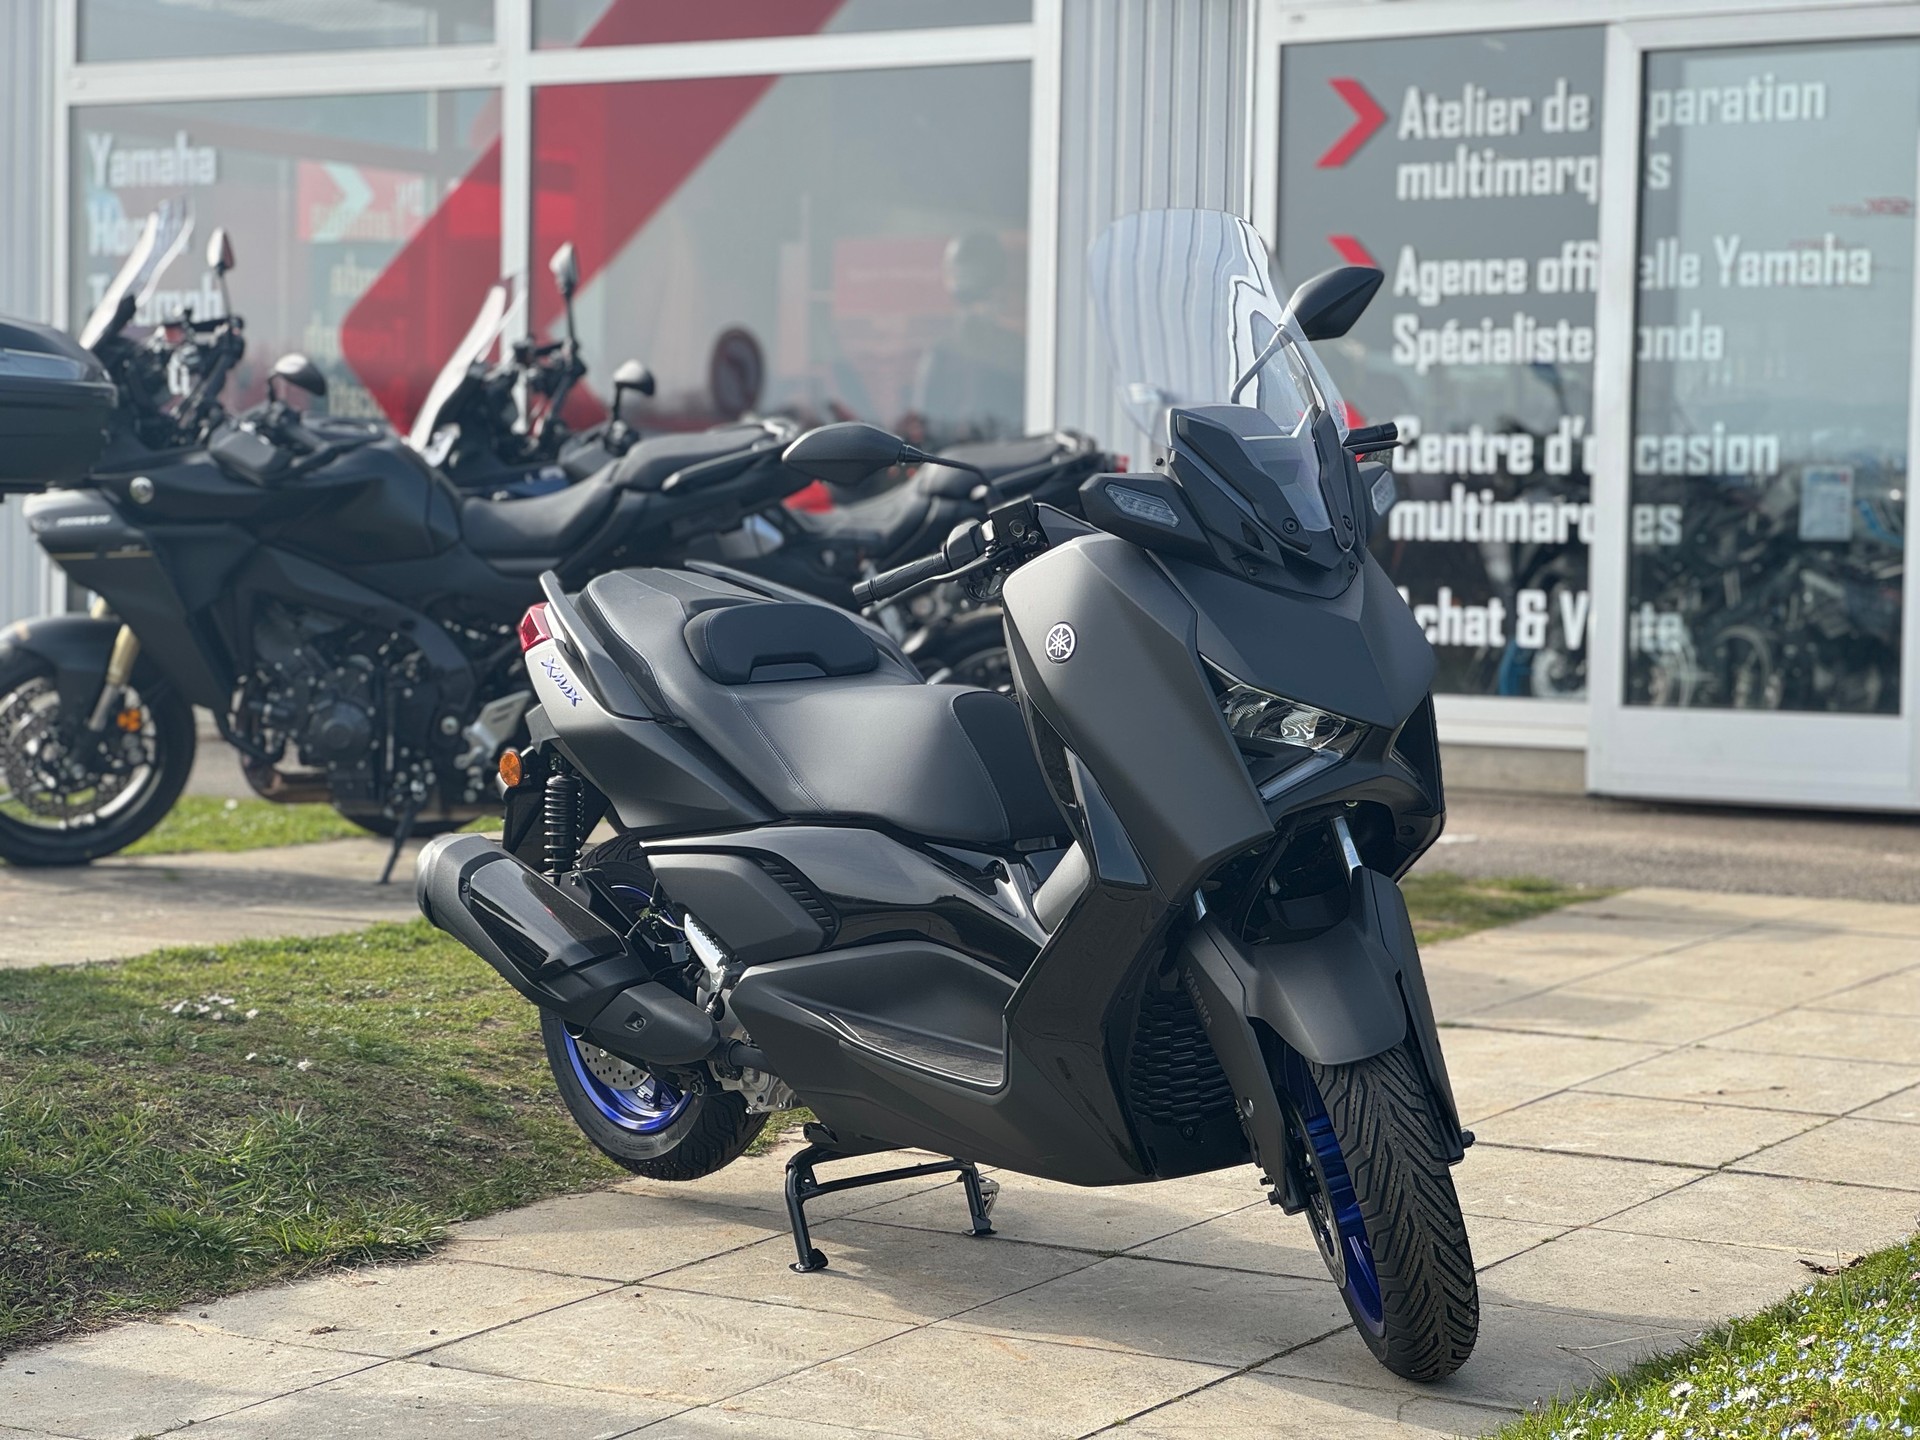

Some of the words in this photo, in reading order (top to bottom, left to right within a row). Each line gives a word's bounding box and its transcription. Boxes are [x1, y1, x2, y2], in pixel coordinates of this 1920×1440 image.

[1398, 83, 1531, 140] Atelier
[1542, 77, 1591, 133] de
[1648, 72, 1826, 139] paration
[87, 129, 217, 188] Yamaha
[1397, 143, 1671, 204] multimarqs
[1393, 244, 1528, 306] Agence
[1537, 236, 1700, 293] offielle
[1713, 231, 1872, 288] Yamaha
[1392, 311, 1594, 376] Spécialiste
[1636, 308, 1725, 361] onda
[1392, 415, 1534, 475] Centre
[1543, 415, 1779, 476] d'casion
[1388, 482, 1683, 545] multimares
[1396, 585, 1506, 648] chat
[1515, 588, 1549, 649] &
[1559, 589, 1684, 653] Vte
[1184, 966, 1212, 1028] YAMAHA
